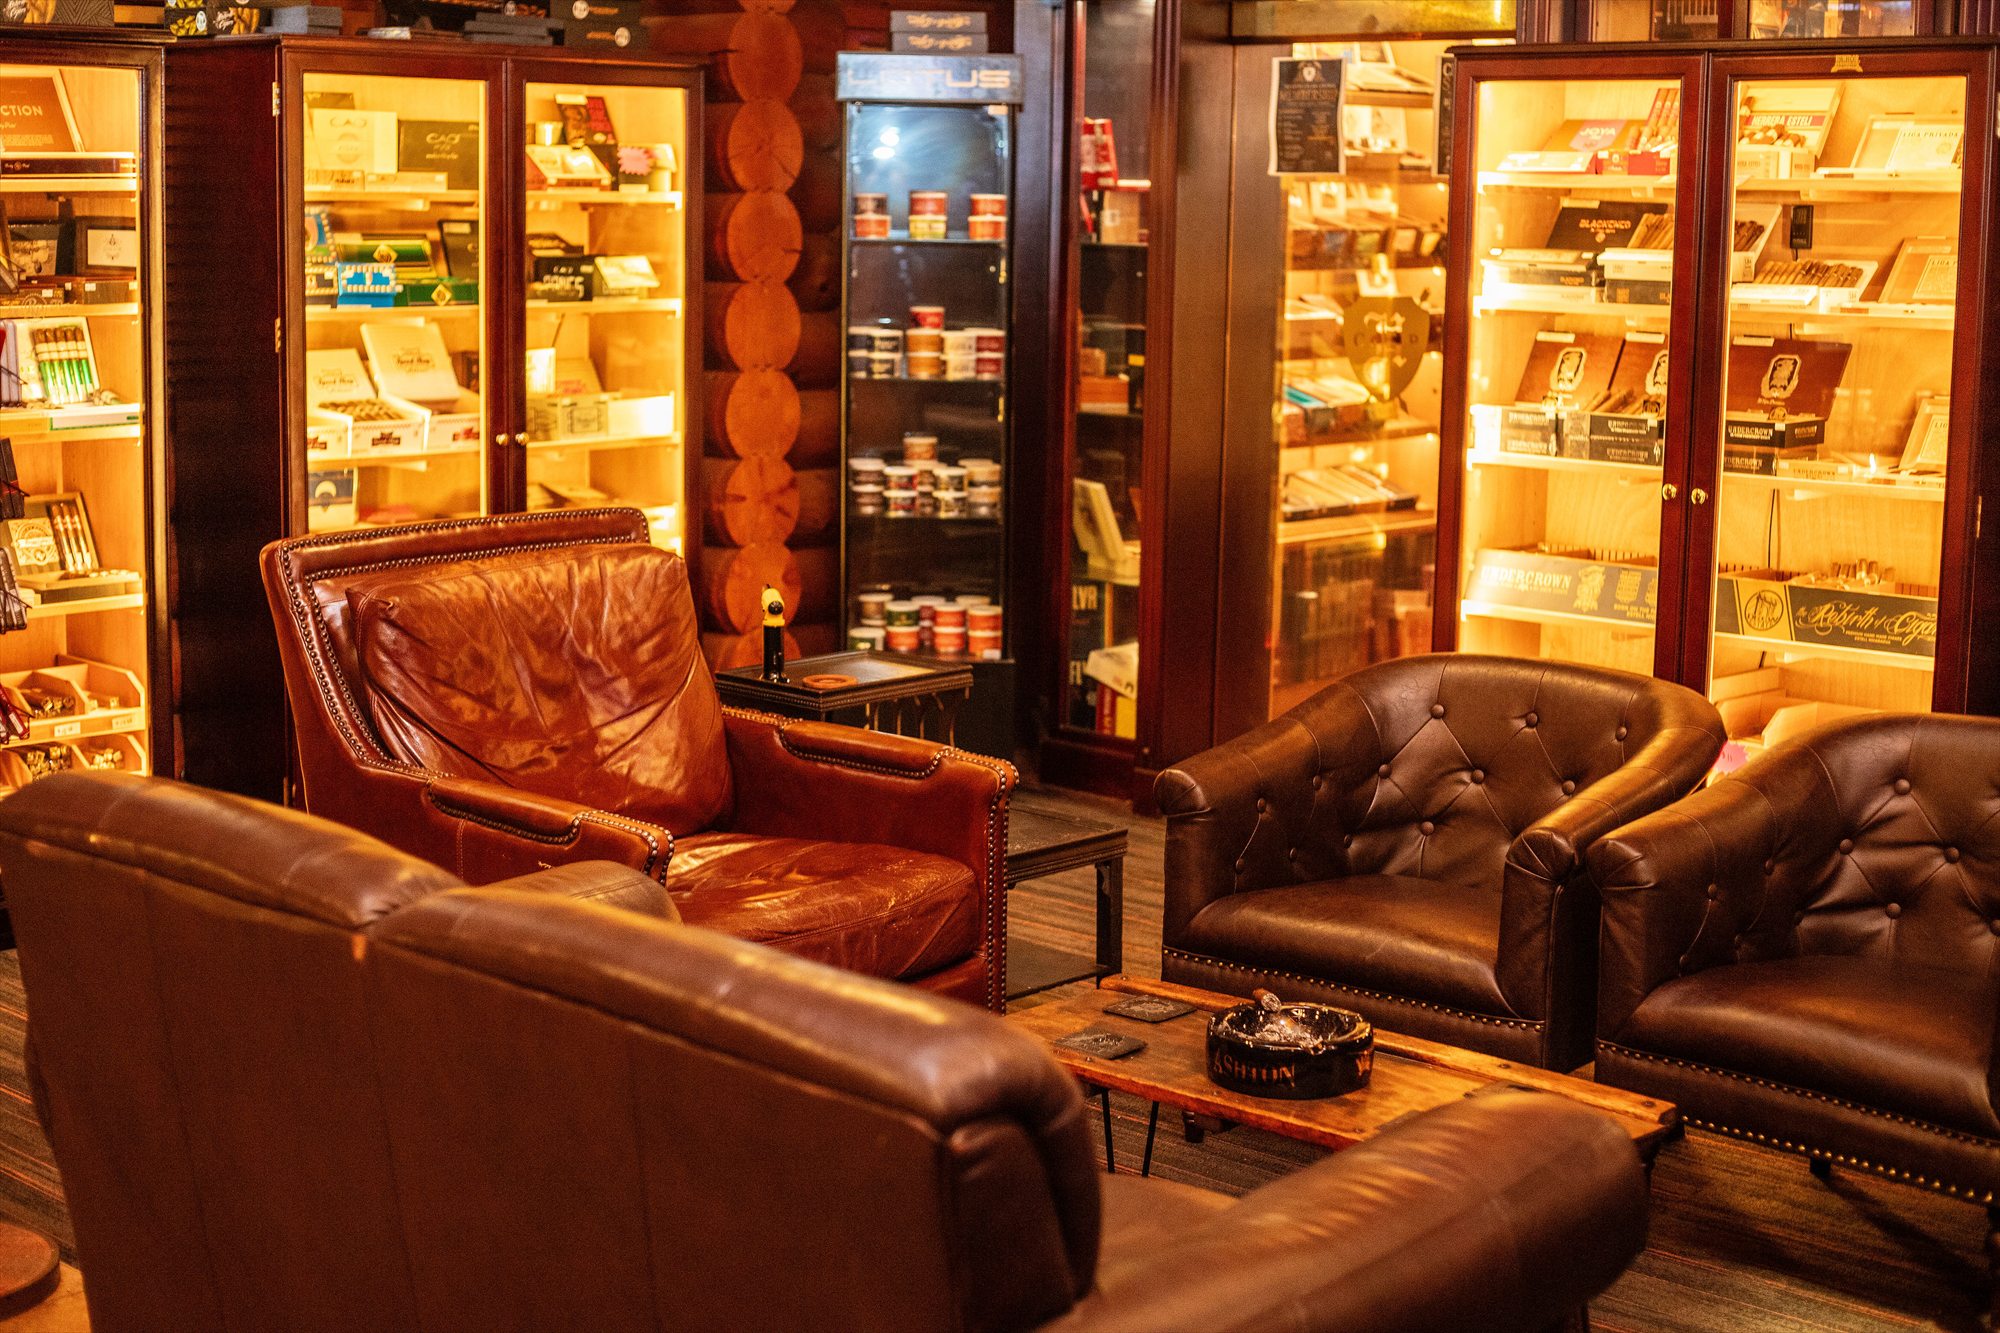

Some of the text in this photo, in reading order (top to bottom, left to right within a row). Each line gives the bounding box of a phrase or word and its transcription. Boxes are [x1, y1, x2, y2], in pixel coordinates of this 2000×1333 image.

[1579, 127, 1617, 137] JOYA
[1727, 425, 1773, 437] UNDERCROWN
[1807, 601, 1879, 636] Rebirth
